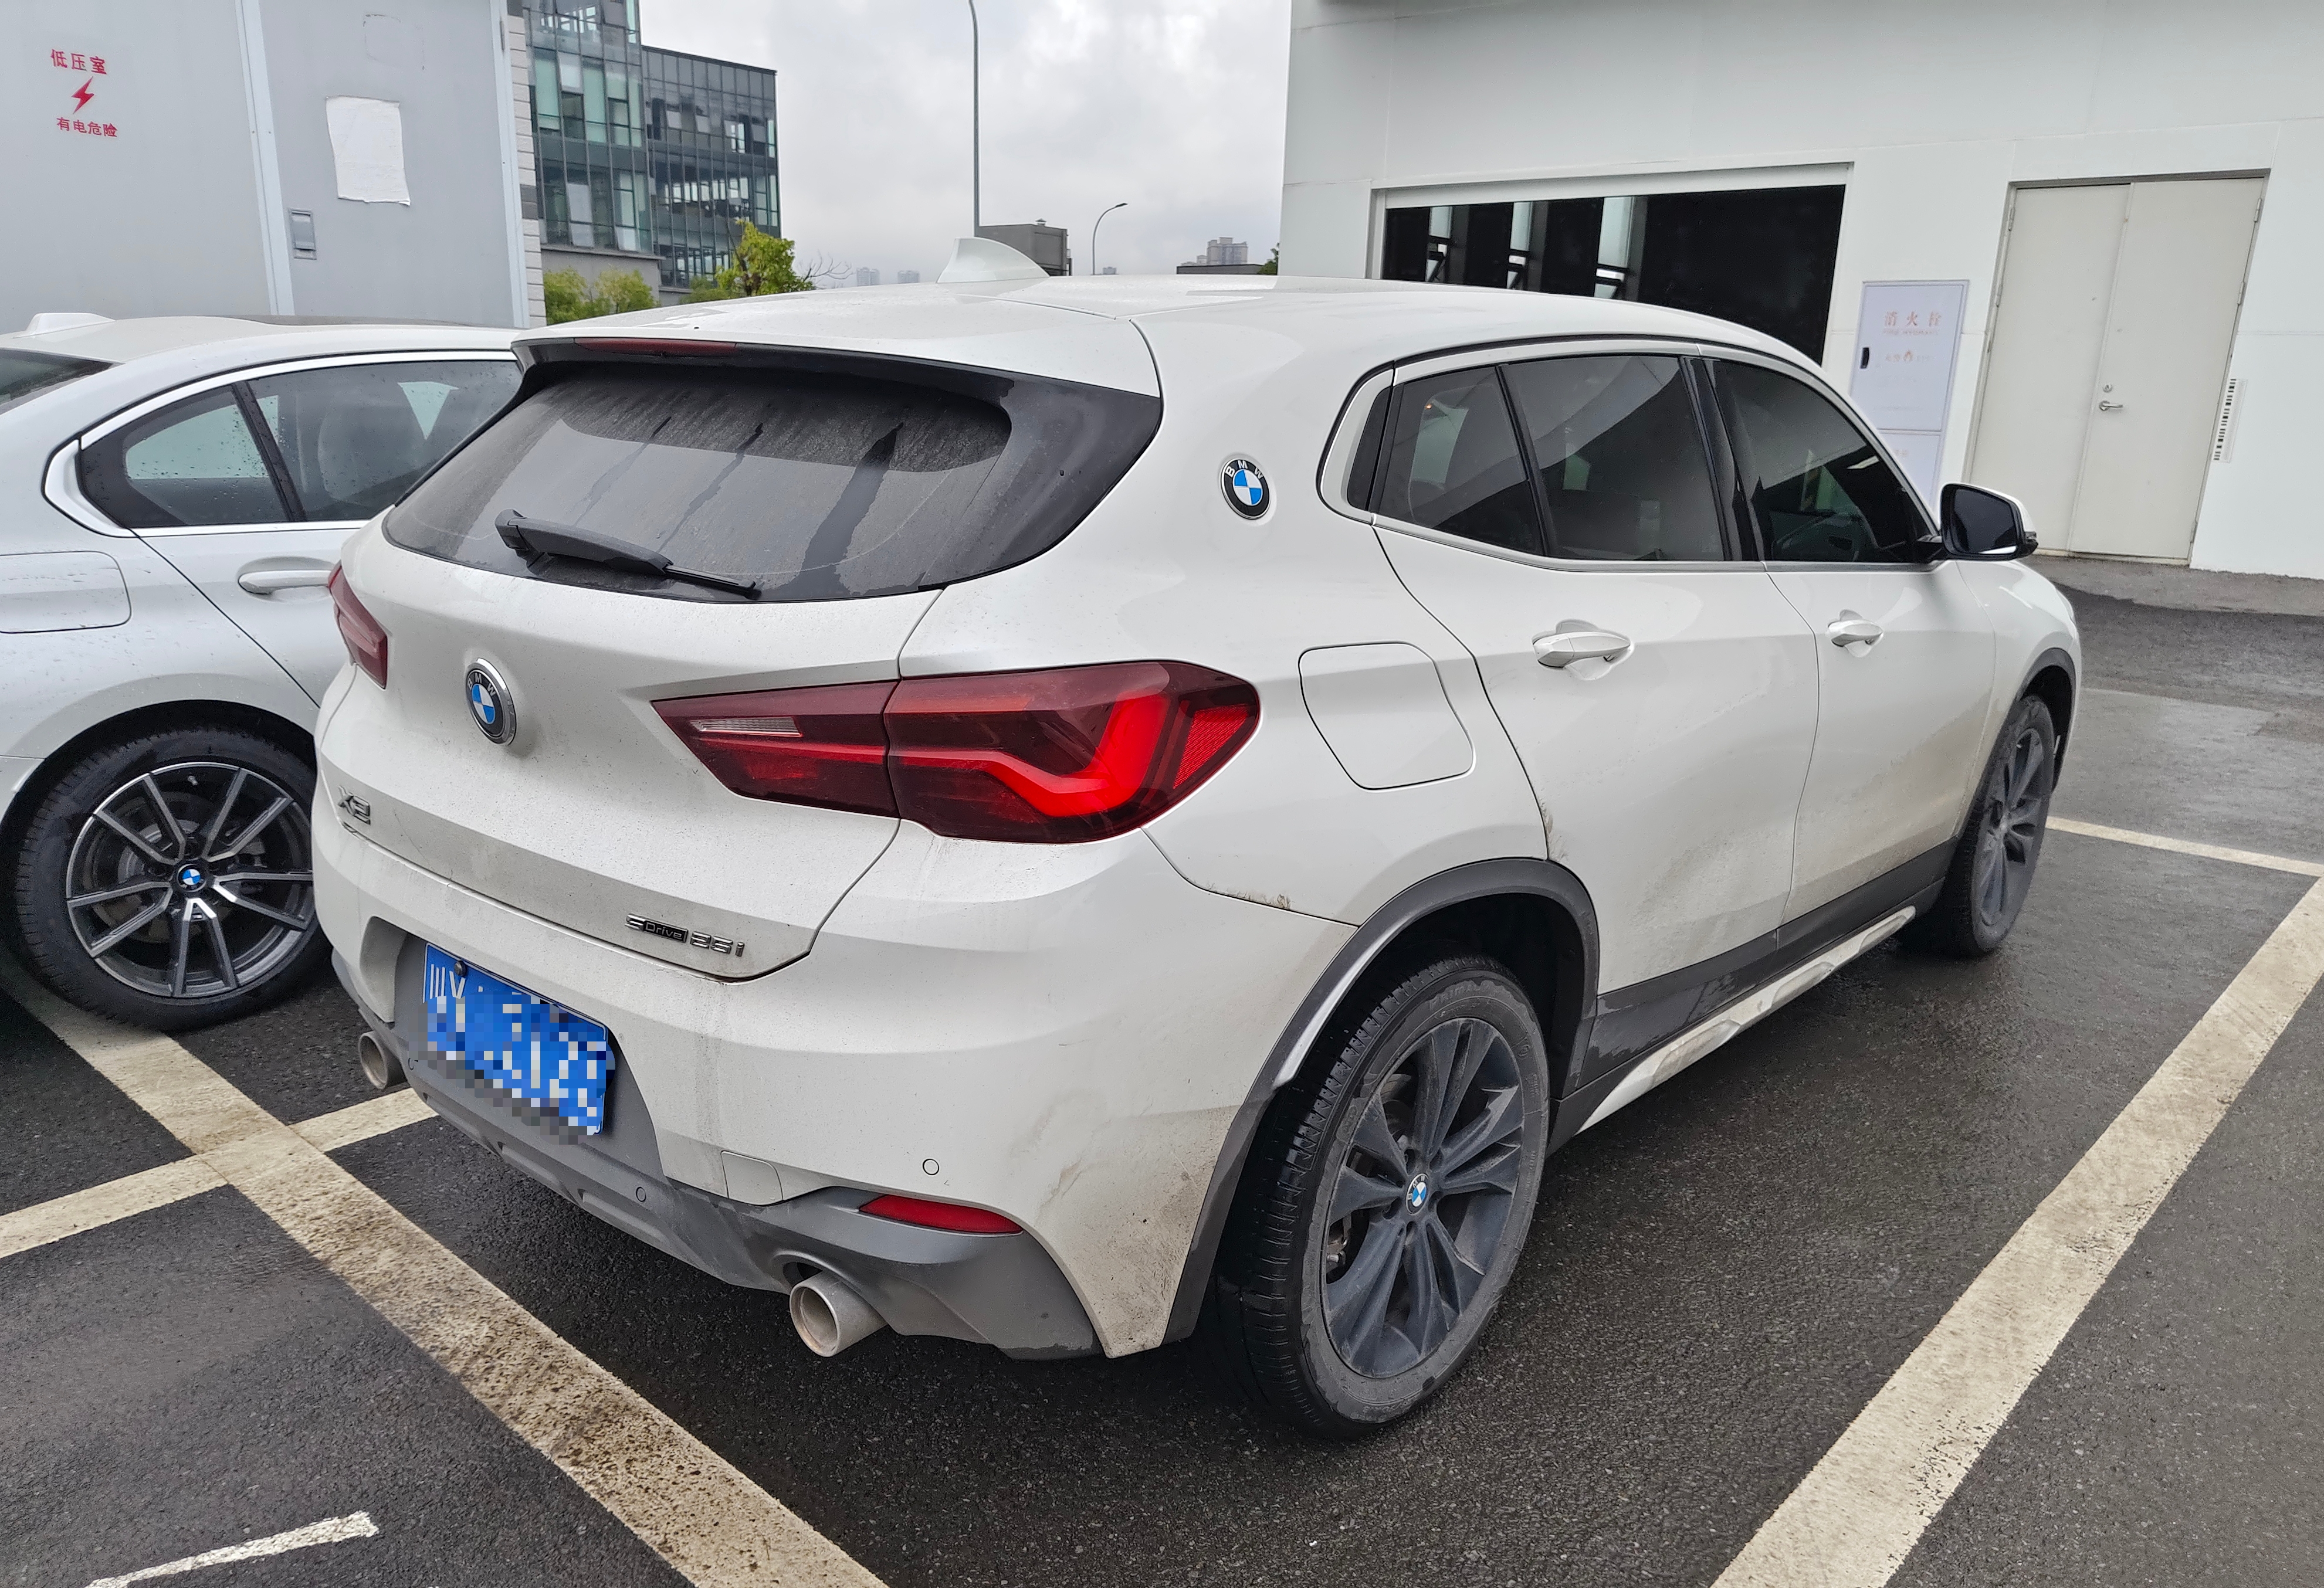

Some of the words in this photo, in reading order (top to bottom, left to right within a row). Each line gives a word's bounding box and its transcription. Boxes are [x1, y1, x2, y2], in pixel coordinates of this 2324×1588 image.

[50, 49, 107, 74] 低压室
[56, 117, 118, 137] 有电危险
[1225, 460, 1263, 479] BMW
[467, 673, 496, 697] BMW
